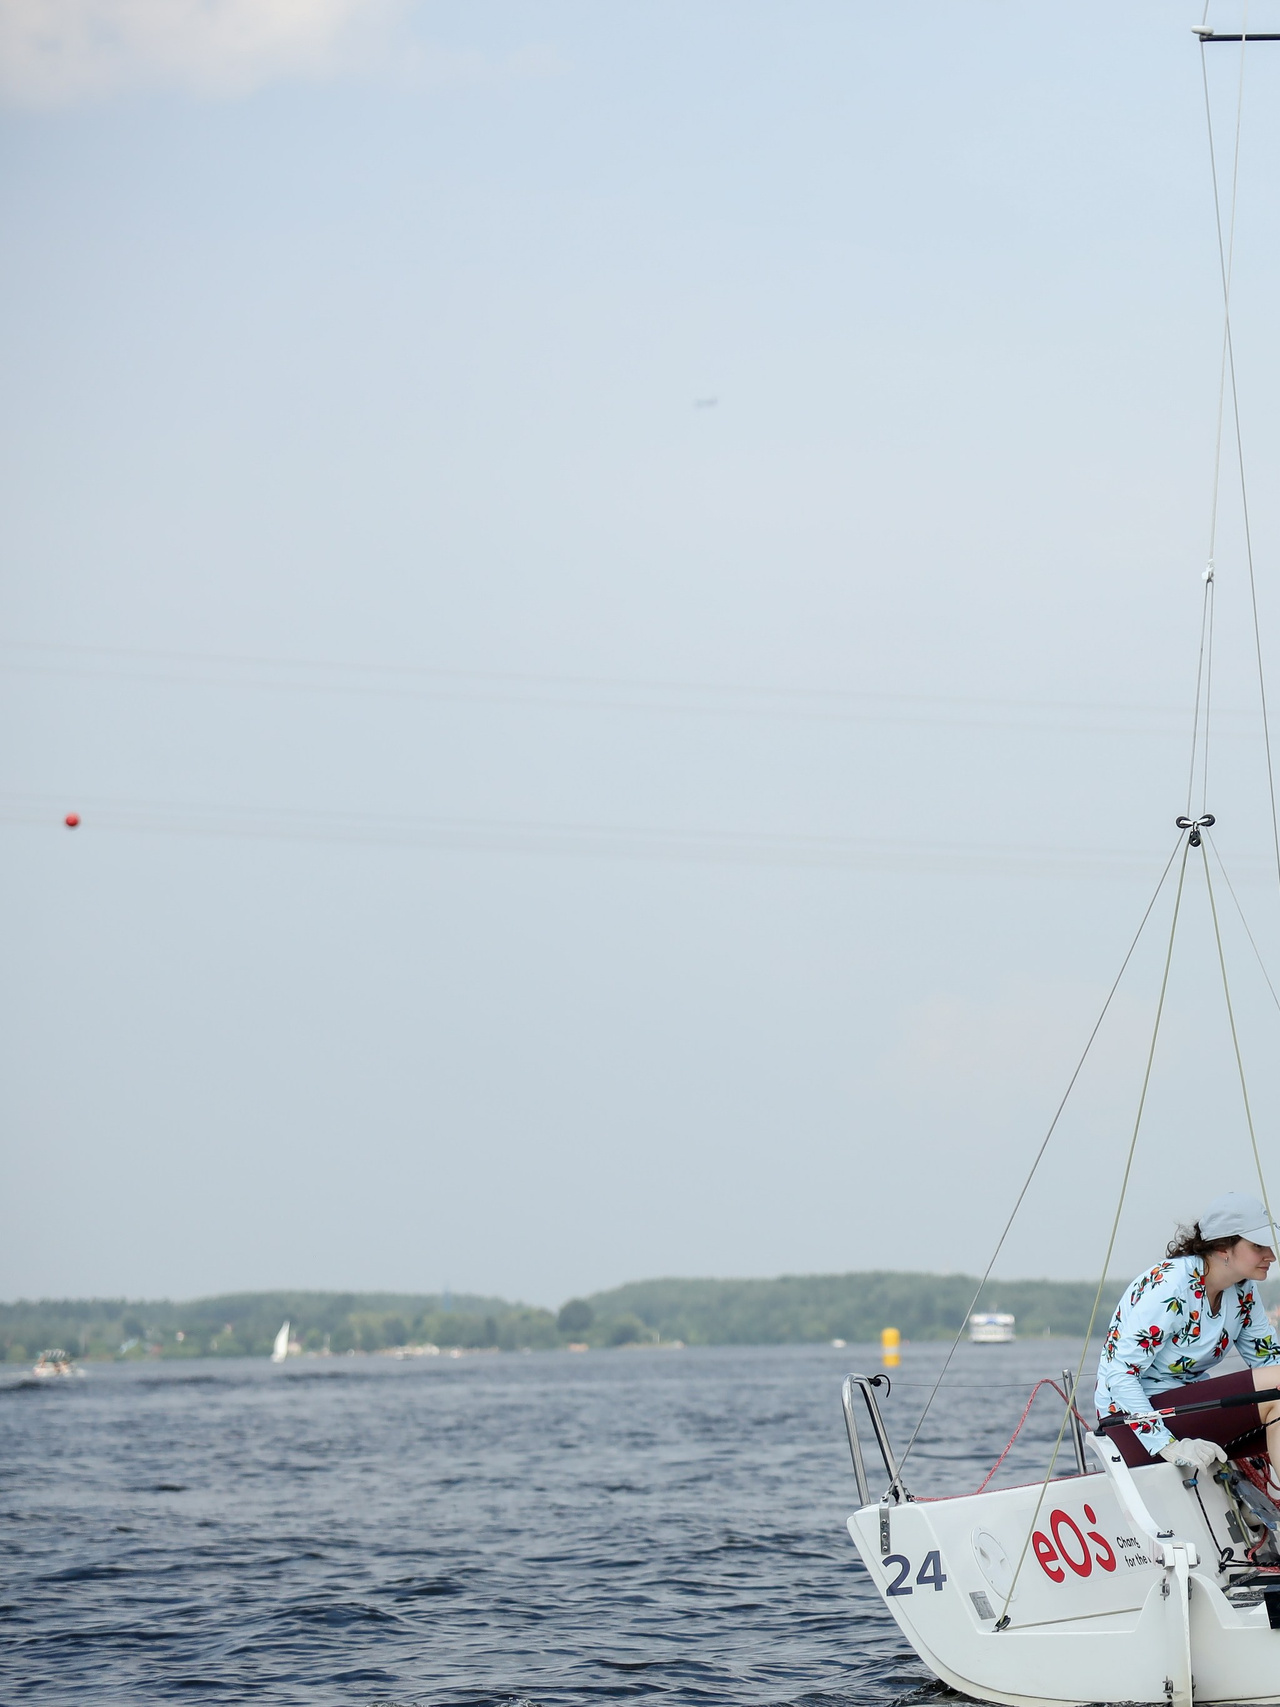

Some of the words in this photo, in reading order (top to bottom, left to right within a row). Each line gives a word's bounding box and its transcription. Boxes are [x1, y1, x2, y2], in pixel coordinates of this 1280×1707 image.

[882, 1550, 947, 1596] 24
[1125, 1555, 1135, 1567] for
[1135, 1553, 1148, 1566] the
